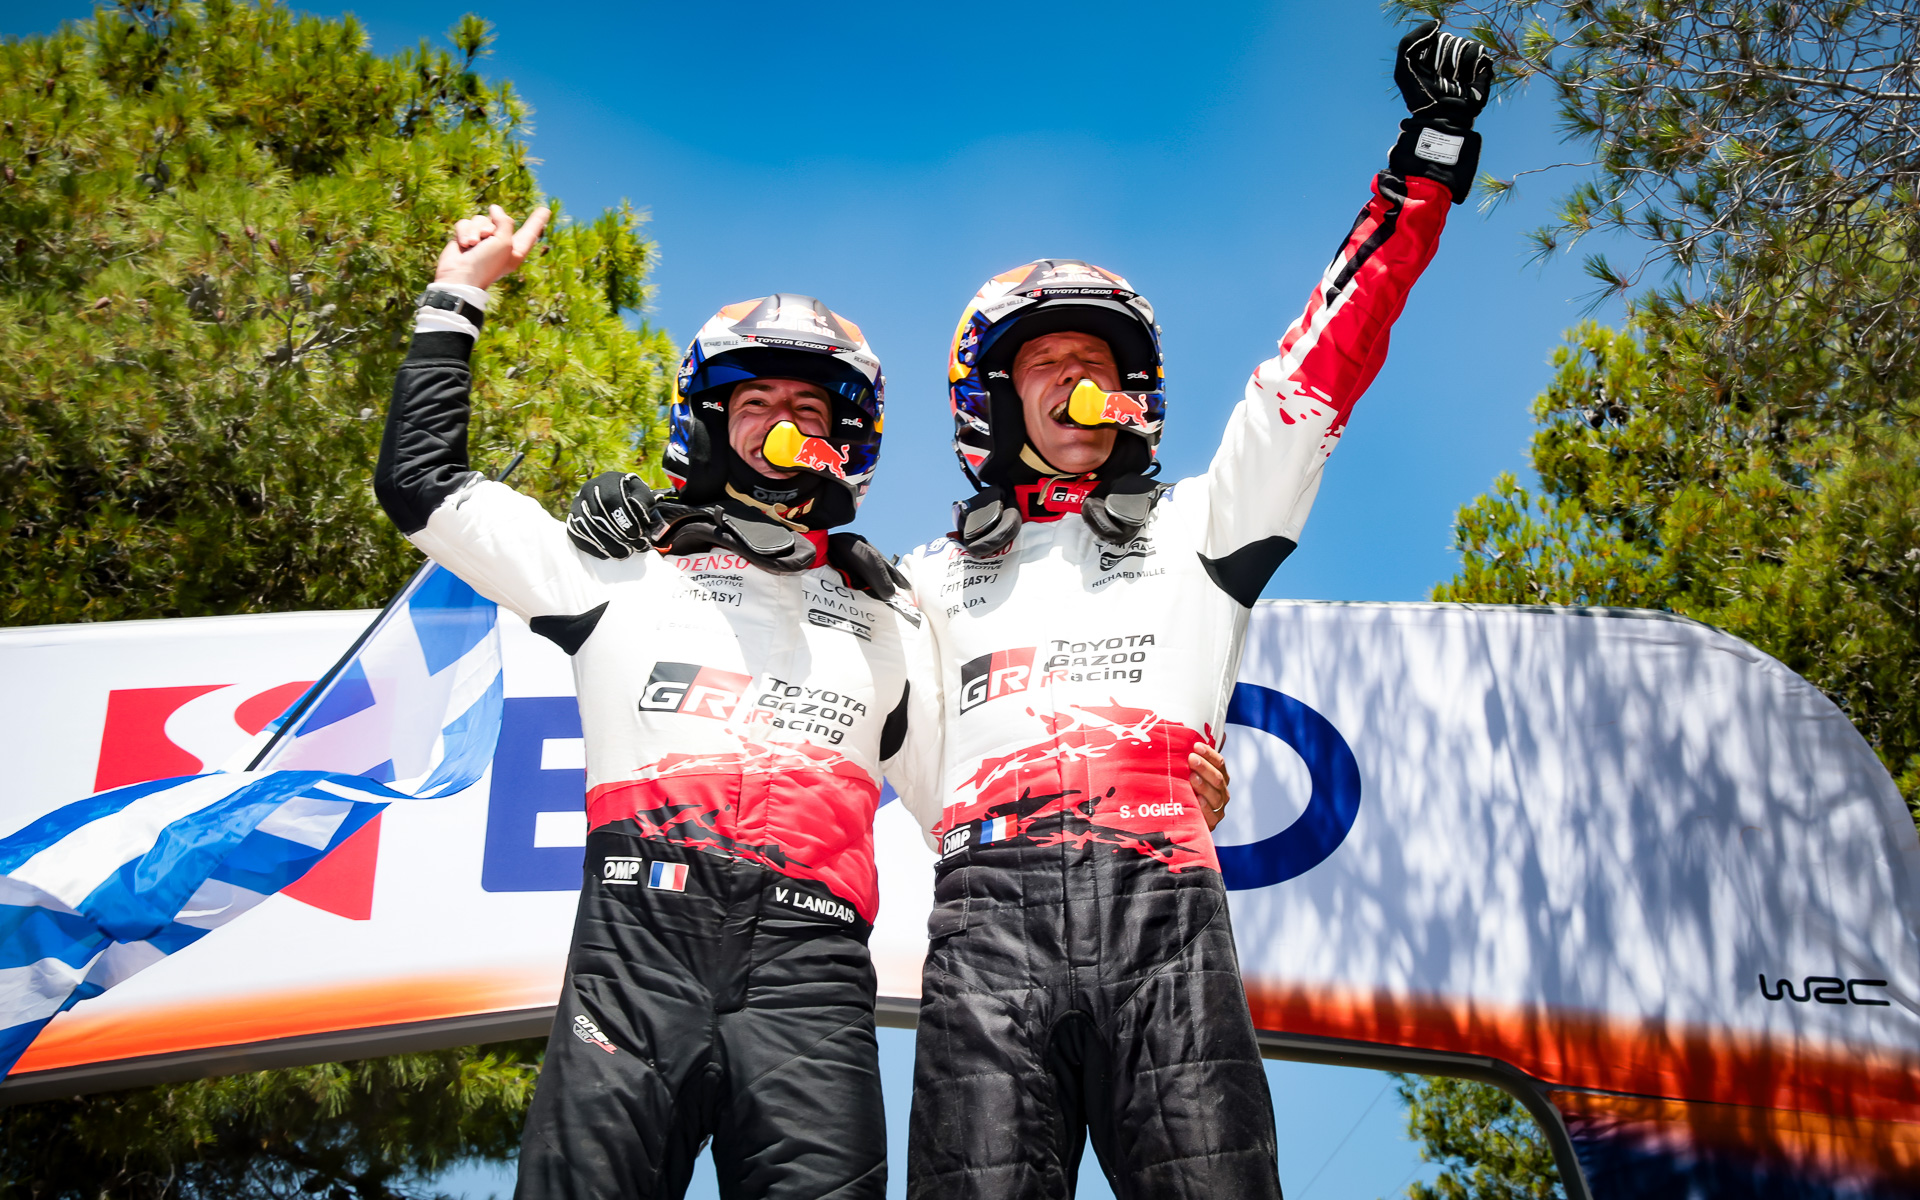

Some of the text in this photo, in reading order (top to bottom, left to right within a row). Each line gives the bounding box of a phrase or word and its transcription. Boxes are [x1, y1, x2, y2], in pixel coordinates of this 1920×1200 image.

[756, 337, 794, 345] TOYOTA
[753, 489, 798, 503] OMP
[1052, 492, 1080, 503] GR
[612, 508, 632, 531] OMP
[1092, 567, 1166, 588] RICHARD MILLE
[802, 590, 876, 622] TAMADIC
[946, 596, 987, 618] PRADA
[1051, 634, 1155, 654] TOYOTA
[960, 664, 1030, 713] GR
[1040, 667, 1143, 688] Racing
[639, 680, 738, 719] GR
[768, 677, 868, 717] TOYOTA
[743, 708, 845, 745] Racing
[1119, 802, 1185, 819] S. OGIER
[943, 829, 971, 856] OMP
[603, 860, 641, 881] OMP
[774, 886, 856, 924] V. LANDAIS
[1758, 973, 1891, 1007] WRC
